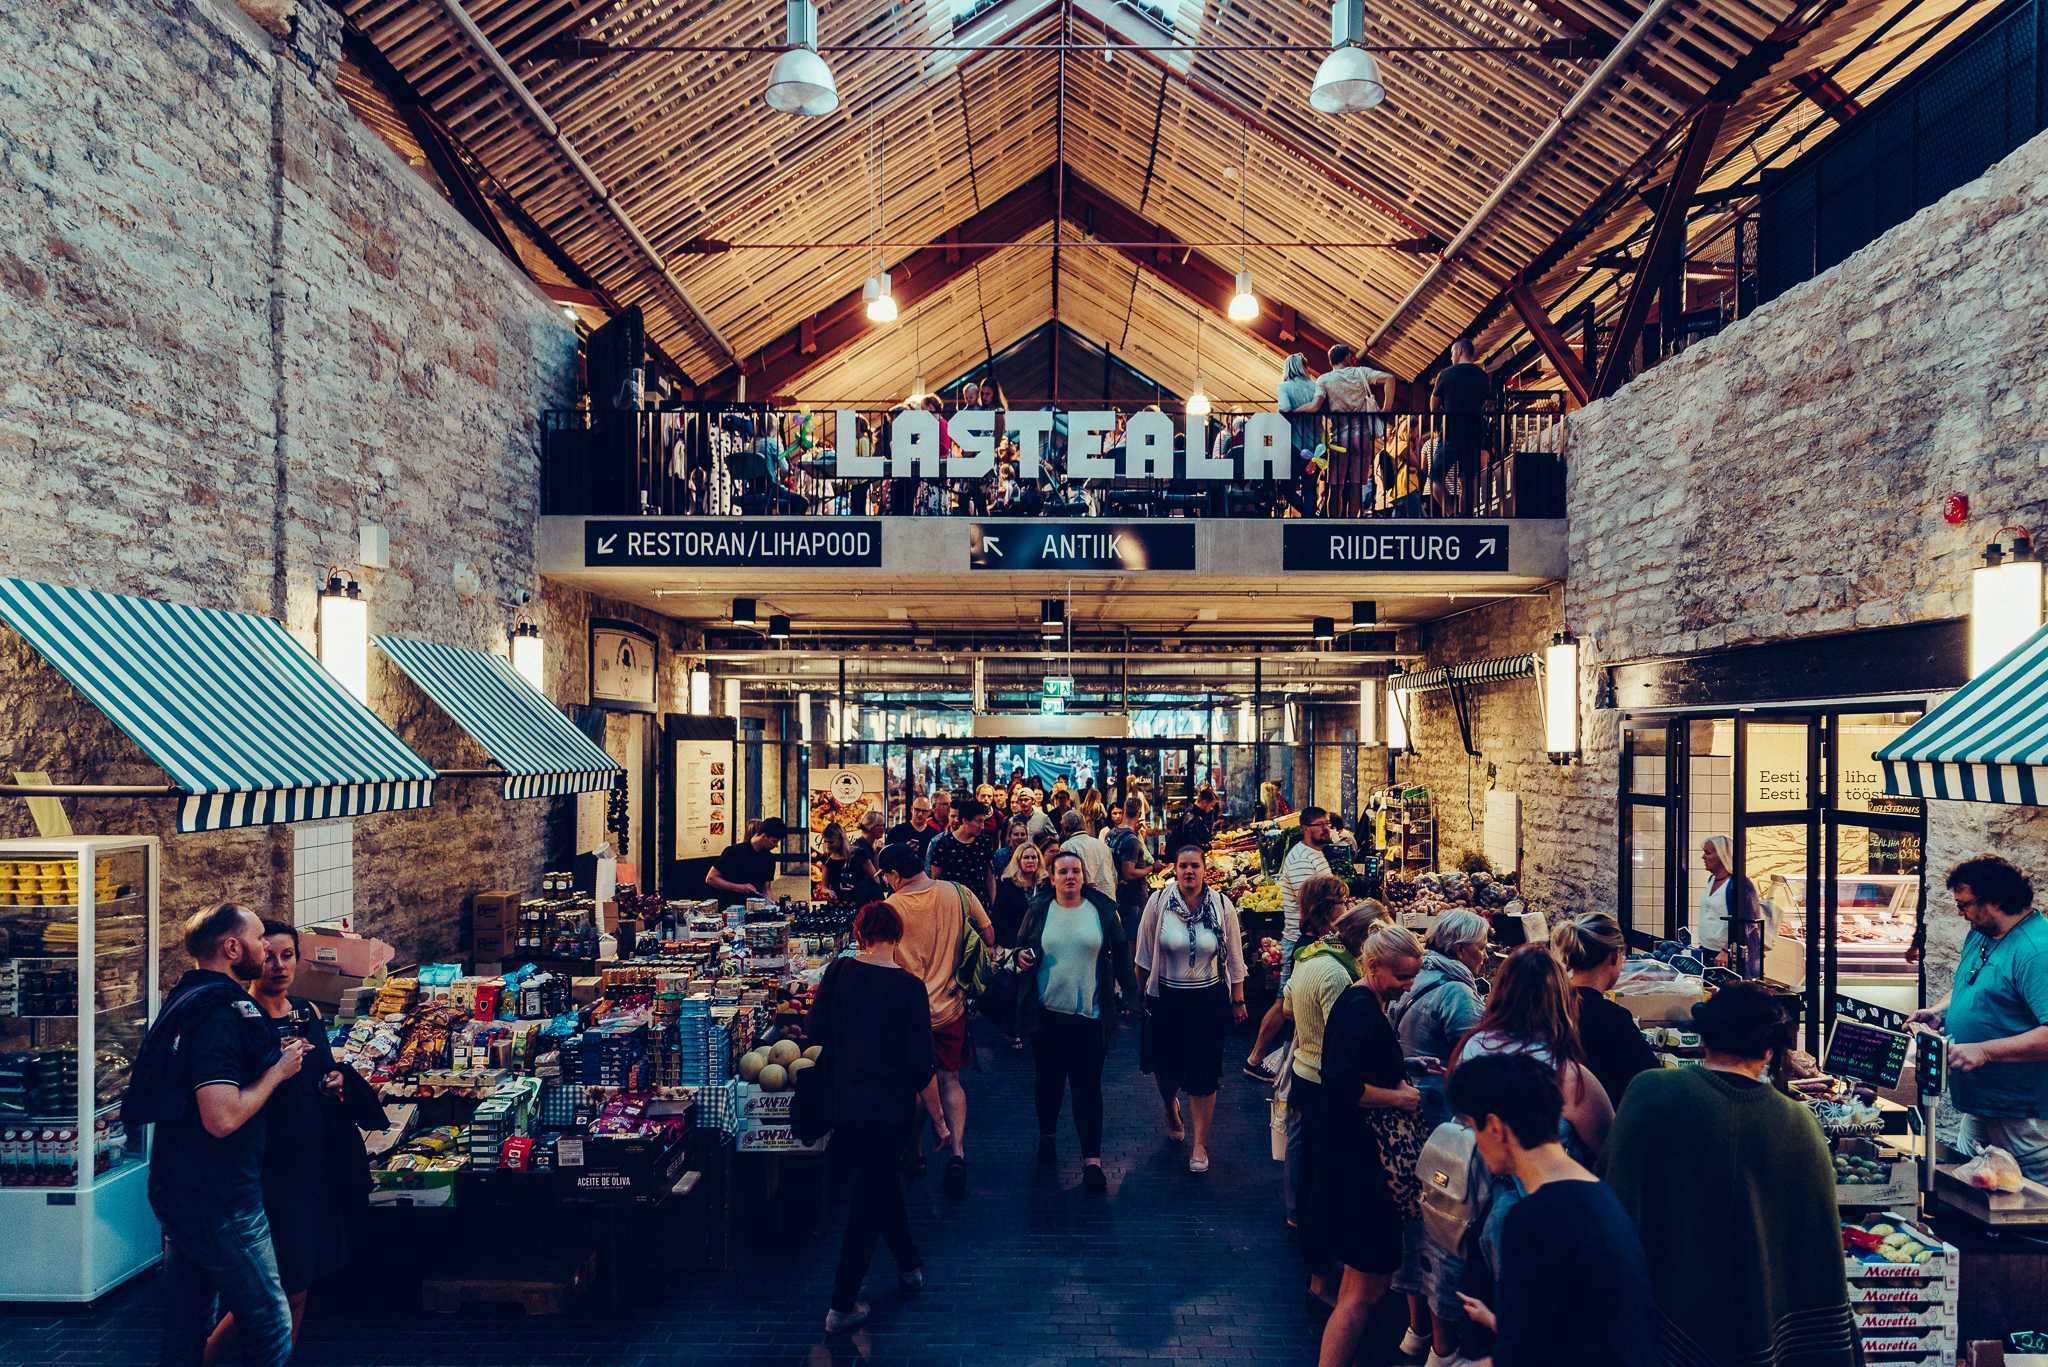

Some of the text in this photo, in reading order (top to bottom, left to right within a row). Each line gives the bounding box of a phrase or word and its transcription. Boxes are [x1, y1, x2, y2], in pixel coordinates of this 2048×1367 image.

[836, 410, 1292, 480] LASTEALA
[627, 531, 871, 558] RESTORAN/LIHAPOOD
[1042, 534, 1124, 559] ANTIIK
[1329, 535, 1461, 561] RIIDETURG
[1759, 770, 1801, 783] Eesti
[1845, 770, 1878, 783] liha
[1759, 787, 1801, 800] Eesti
[577, 1176, 631, 1187] ACEITE DE OLIVA
[1864, 1266, 1921, 1278] Moretta
[1863, 1290, 1919, 1302] Moretta
[1862, 1315, 1918, 1327] Moretta
[1863, 1339, 1918, 1351] Moretta
